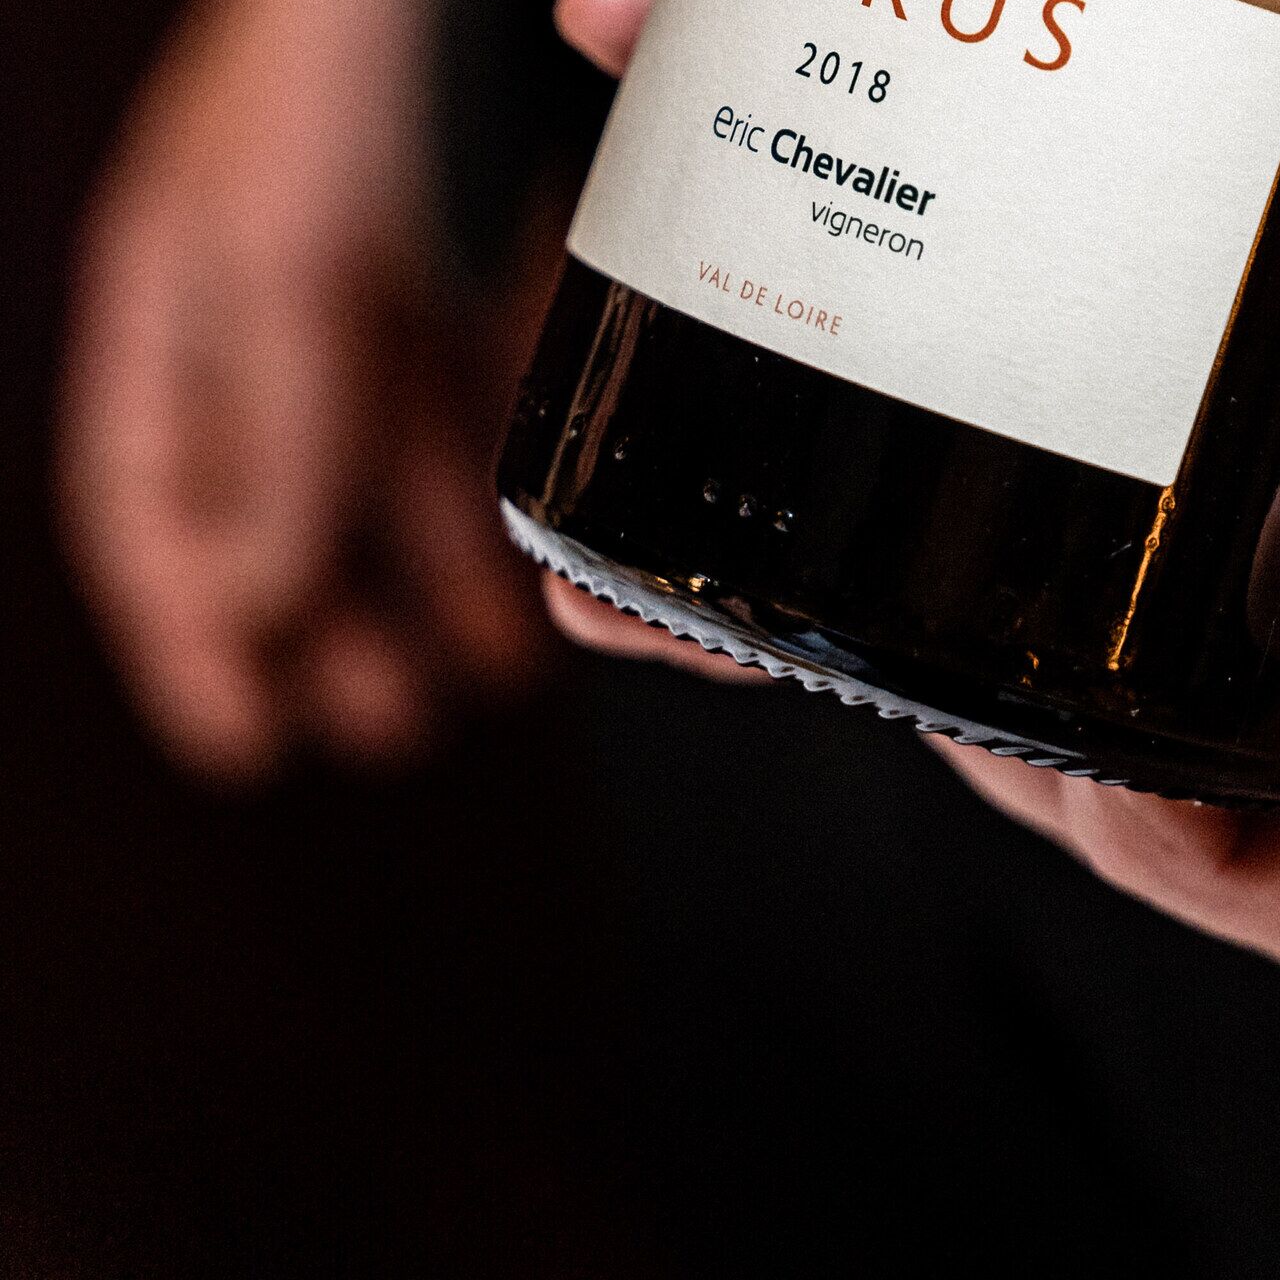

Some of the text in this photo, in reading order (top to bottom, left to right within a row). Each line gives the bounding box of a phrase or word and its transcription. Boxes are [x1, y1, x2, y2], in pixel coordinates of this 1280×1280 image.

[795, 42, 891, 103] 2018
[713, 105, 936, 216] eric Chevalier
[812, 201, 924, 260] vigneron
[699, 261, 843, 336] VAL DE LOIRE
